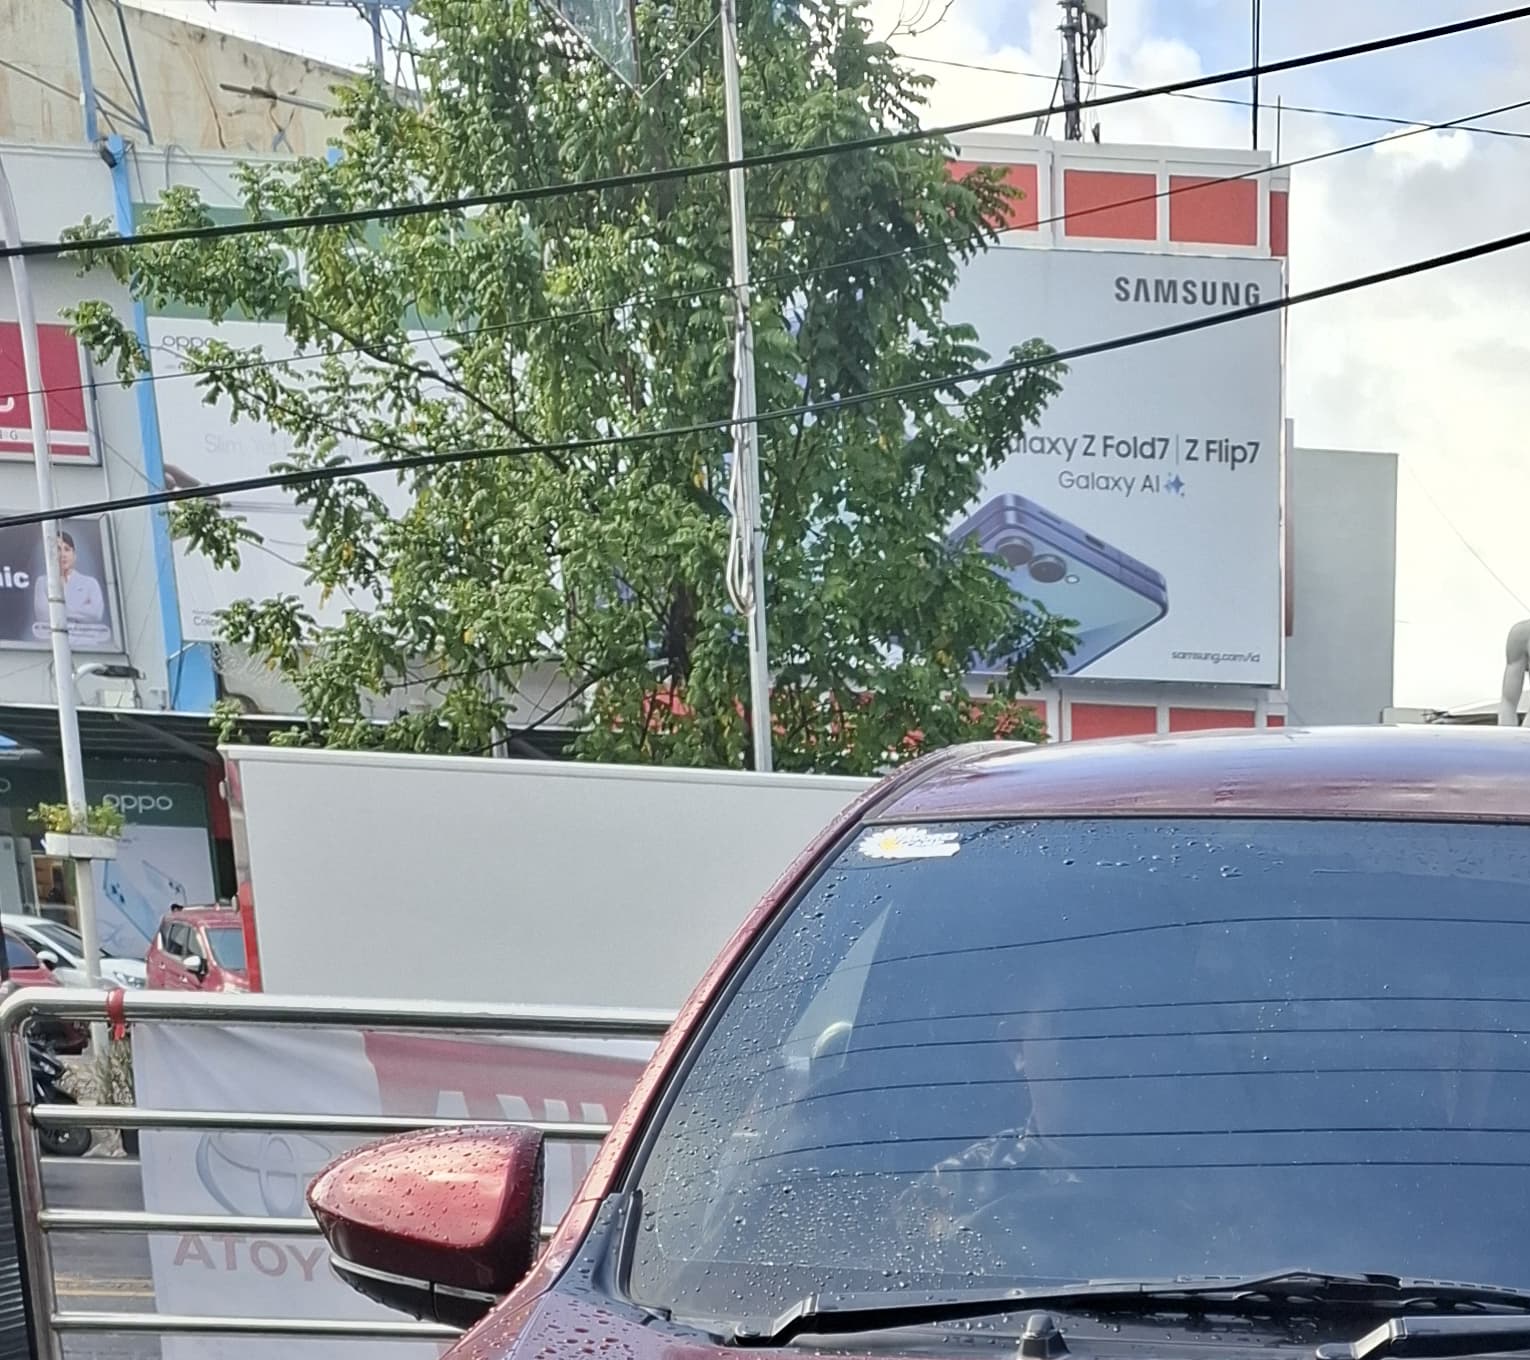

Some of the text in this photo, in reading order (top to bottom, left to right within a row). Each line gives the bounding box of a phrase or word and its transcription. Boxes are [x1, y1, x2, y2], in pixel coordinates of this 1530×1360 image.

[1114, 276, 1261, 307] SAMSUNG
[1008, 432, 1260, 471] alaxy Z Fold7 Z Flip7
[1058, 470, 1160, 497] Galaxy AI
[1171, 649, 1260, 664] samsung.com/id
